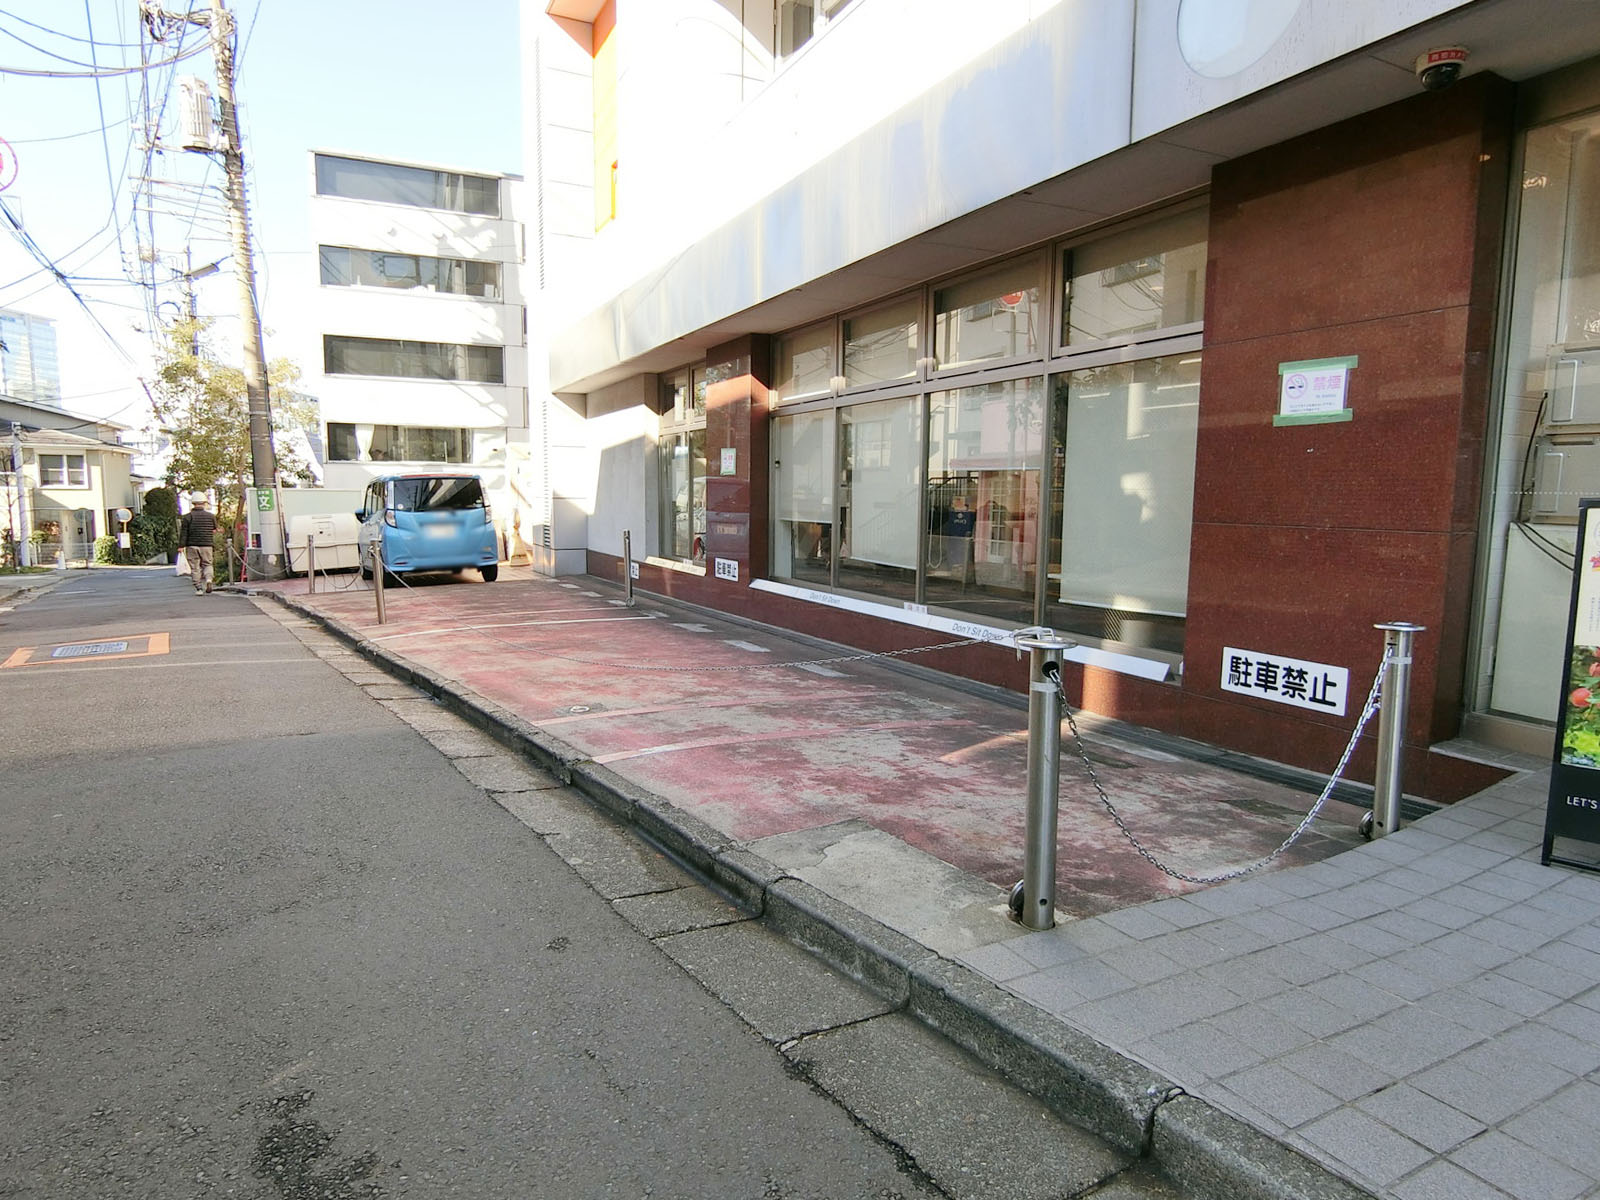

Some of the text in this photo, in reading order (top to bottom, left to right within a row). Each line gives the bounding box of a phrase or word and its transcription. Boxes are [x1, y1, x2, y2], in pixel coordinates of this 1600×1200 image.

[1313, 375, 1342, 391] 禁煙
[952, 623, 971, 633] Don't
[971, 626, 982, 636] Sit
[1228, 655, 1337, 707] 駐車禁止
[1566, 795, 1598, 810] LET'S
